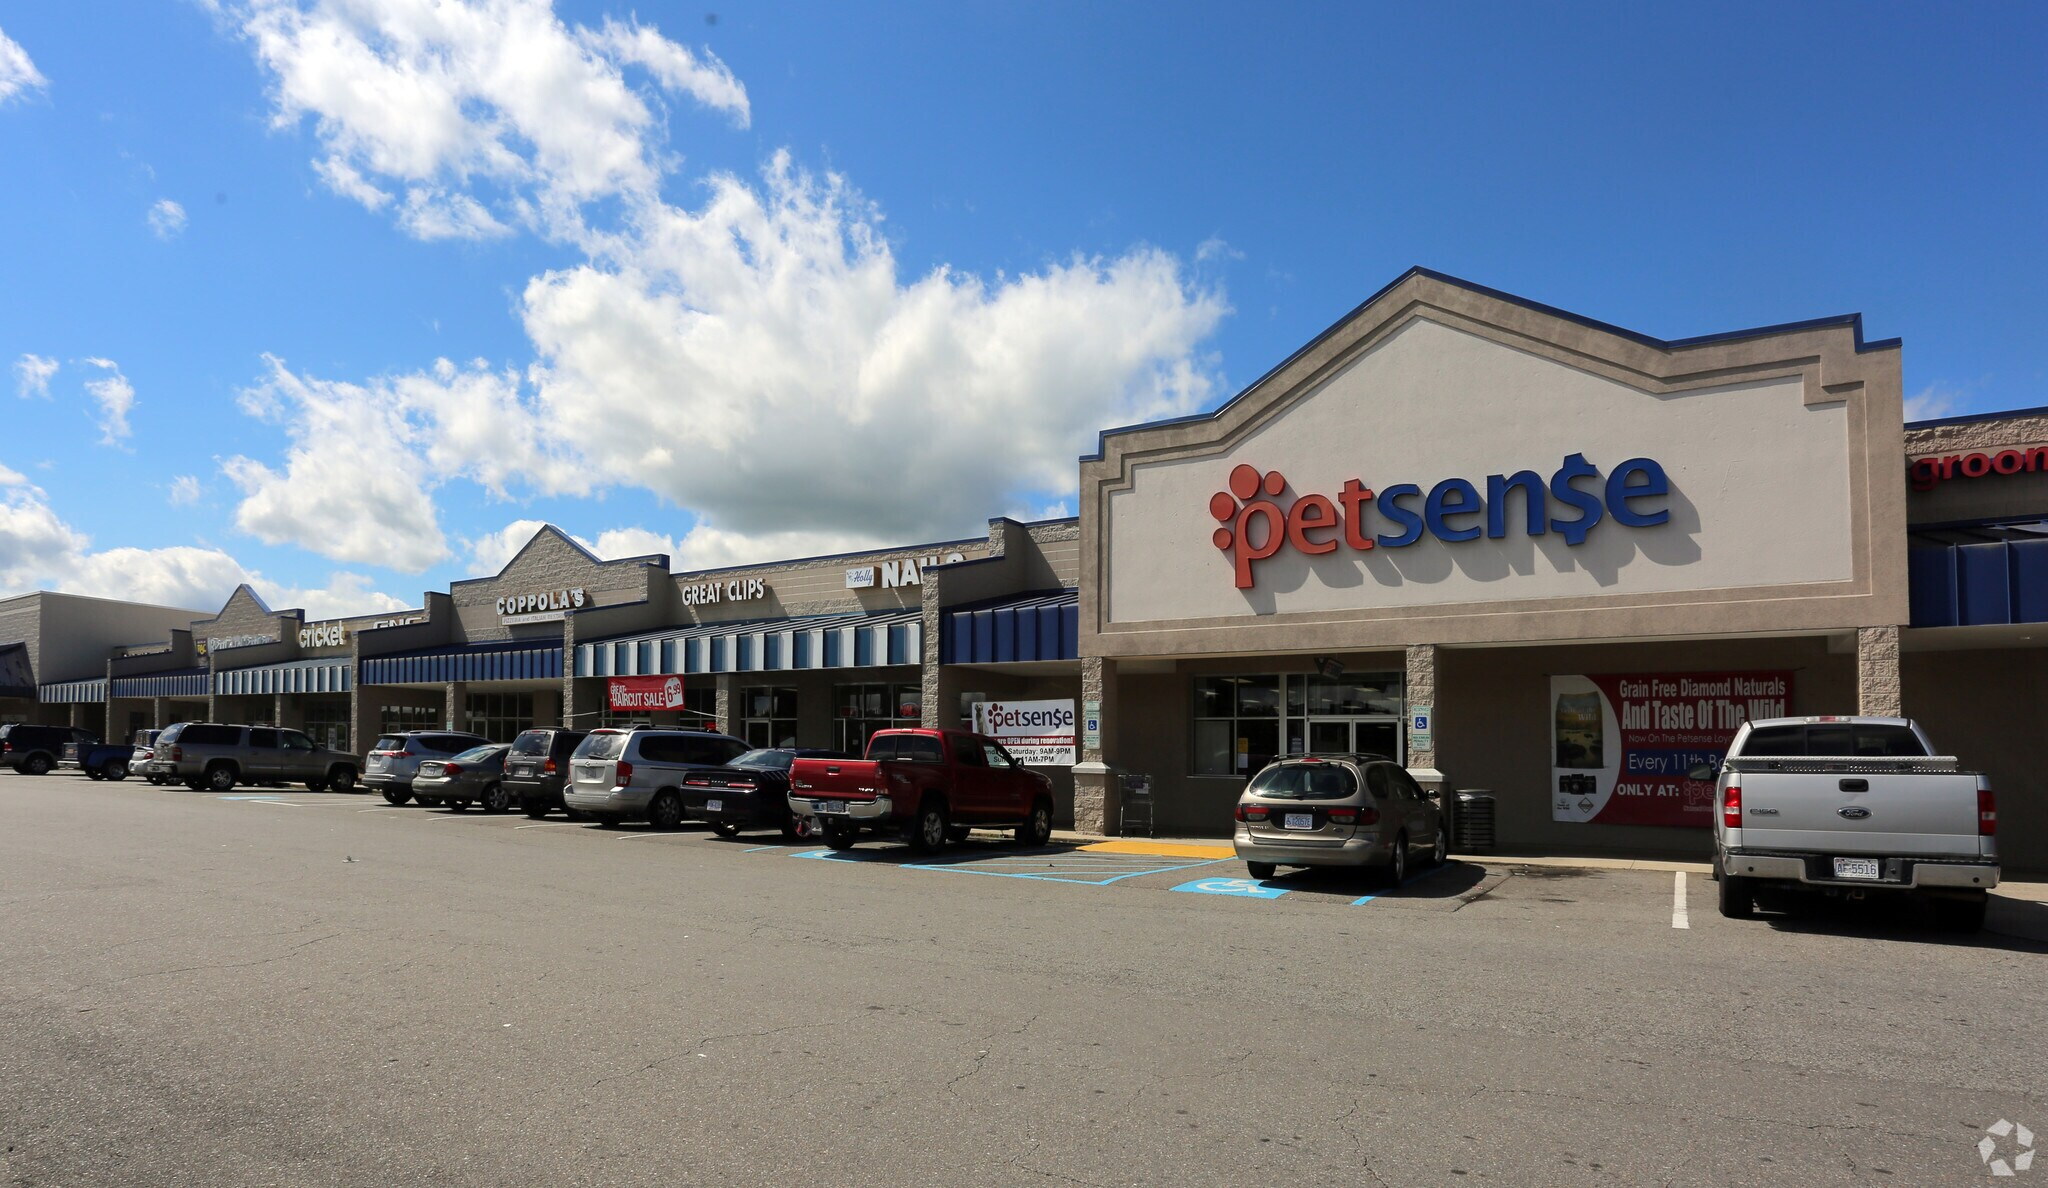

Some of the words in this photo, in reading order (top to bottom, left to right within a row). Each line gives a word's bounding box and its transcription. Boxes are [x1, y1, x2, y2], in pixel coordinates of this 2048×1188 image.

[853, 569, 874, 586] Holly
[681, 582, 722, 606] GREAT
[727, 578, 766, 602] CLIPS
[496, 588, 584, 615] COPPOLA'S
[299, 620, 345, 649] cricket
[611, 684, 625, 694] GREAT
[667, 683, 681, 703] 6.99
[1620, 680, 1649, 698] Grain
[1652, 679, 1677, 698] Free
[1681, 678, 1731, 697] Diamond
[1734, 677, 1786, 695] Naturals
[613, 692, 642, 707] HAIRCUT
[644, 692, 664, 707] SALE
[1622, 701, 1649, 730] And
[1652, 700, 1694, 730] Taste
[1698, 699, 1713, 730] Of
[1716, 699, 1745, 729] The
[1749, 698, 1785, 722] Wild
[1008, 737, 1021, 745] OPEN
[1021, 736, 1040, 746] during
[1041, 736, 1073, 745] renovation!
[1628, 734, 1647, 743] Now
[1648, 734, 1660, 743] On
[1662, 734, 1675, 743] The
[1677, 734, 1713, 743] Petsense
[1715, 733, 1736, 744] Loya
[1008, 747, 1039, 756] Saturday:
[1039, 747, 1071, 755] 9AM-9PM
[1629, 754, 1668, 773] Every
[1617, 784, 1653, 796] ONLY
[1657, 784, 1680, 796] AT:
[1845, 809, 1865, 817] Ford
